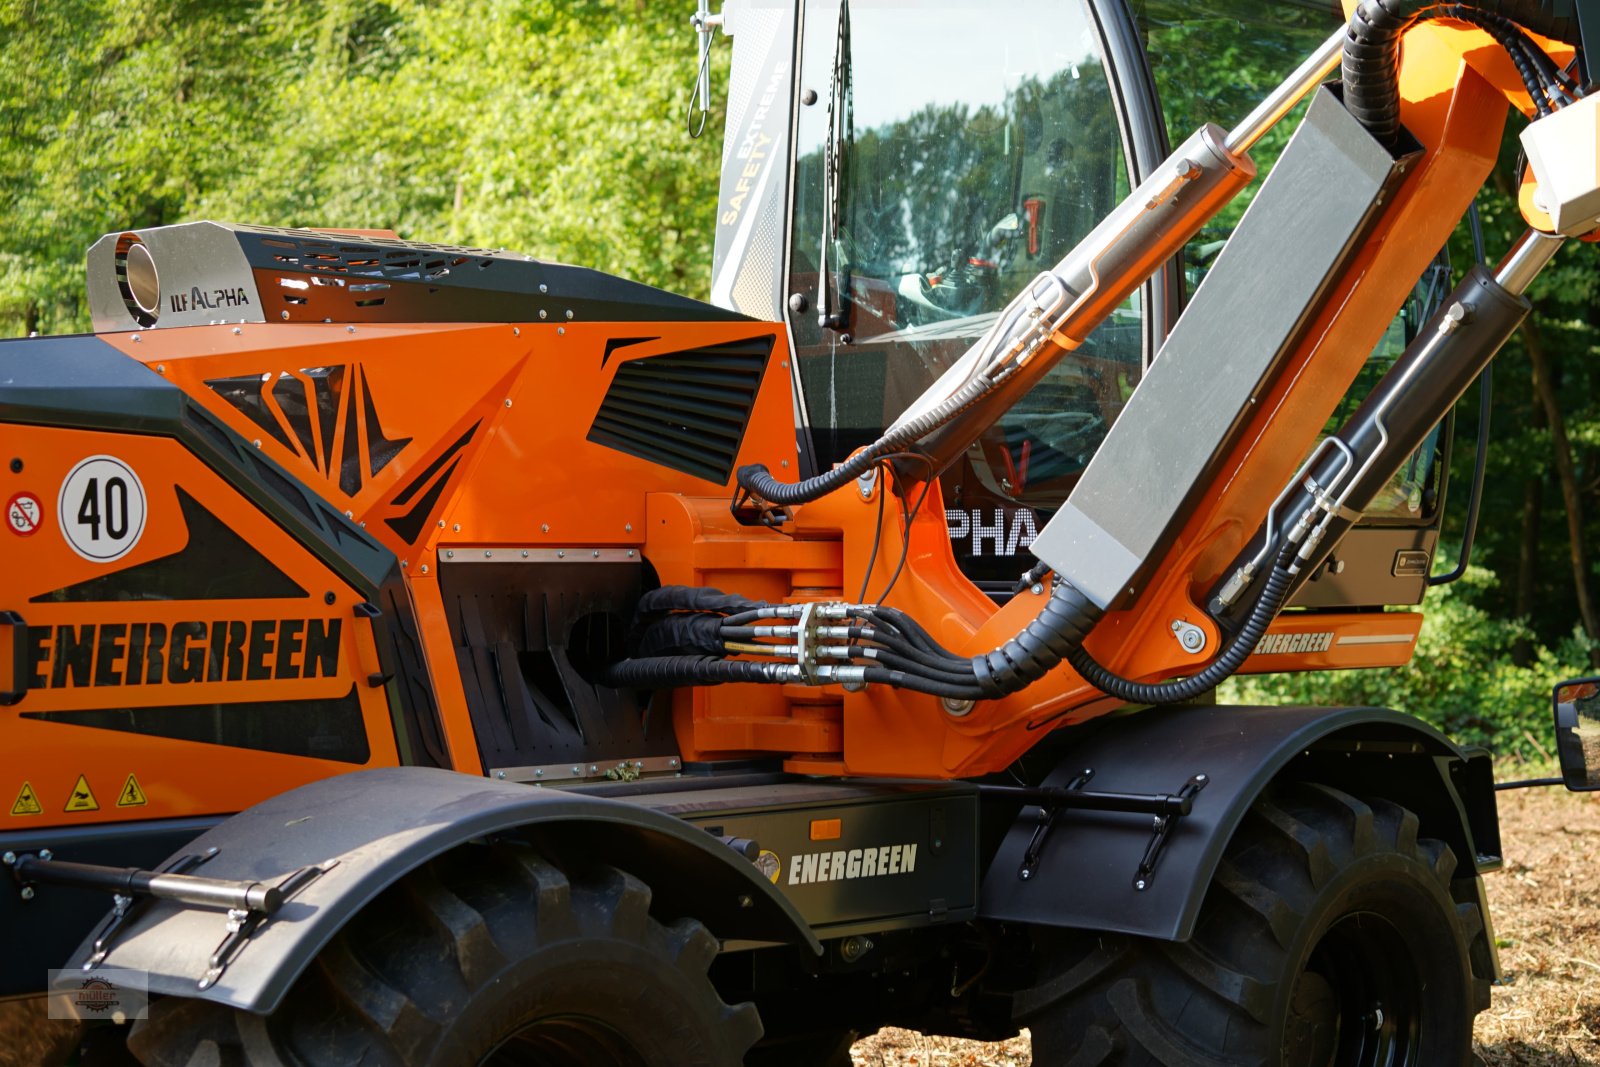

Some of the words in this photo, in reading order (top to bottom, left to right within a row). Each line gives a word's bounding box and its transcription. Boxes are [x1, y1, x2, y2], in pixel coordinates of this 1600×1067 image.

[736, 60, 789, 159] EXTREME
[721, 131, 772, 226] SAFETY
[170, 294, 187, 312] ILF
[192, 286, 249, 310] ALPHA
[78, 477, 128, 541] 40
[26, 618, 343, 689] ENERGREEN
[1254, 632, 1335, 655] ENERGREEN
[788, 843, 918, 886] ENERGREEN
